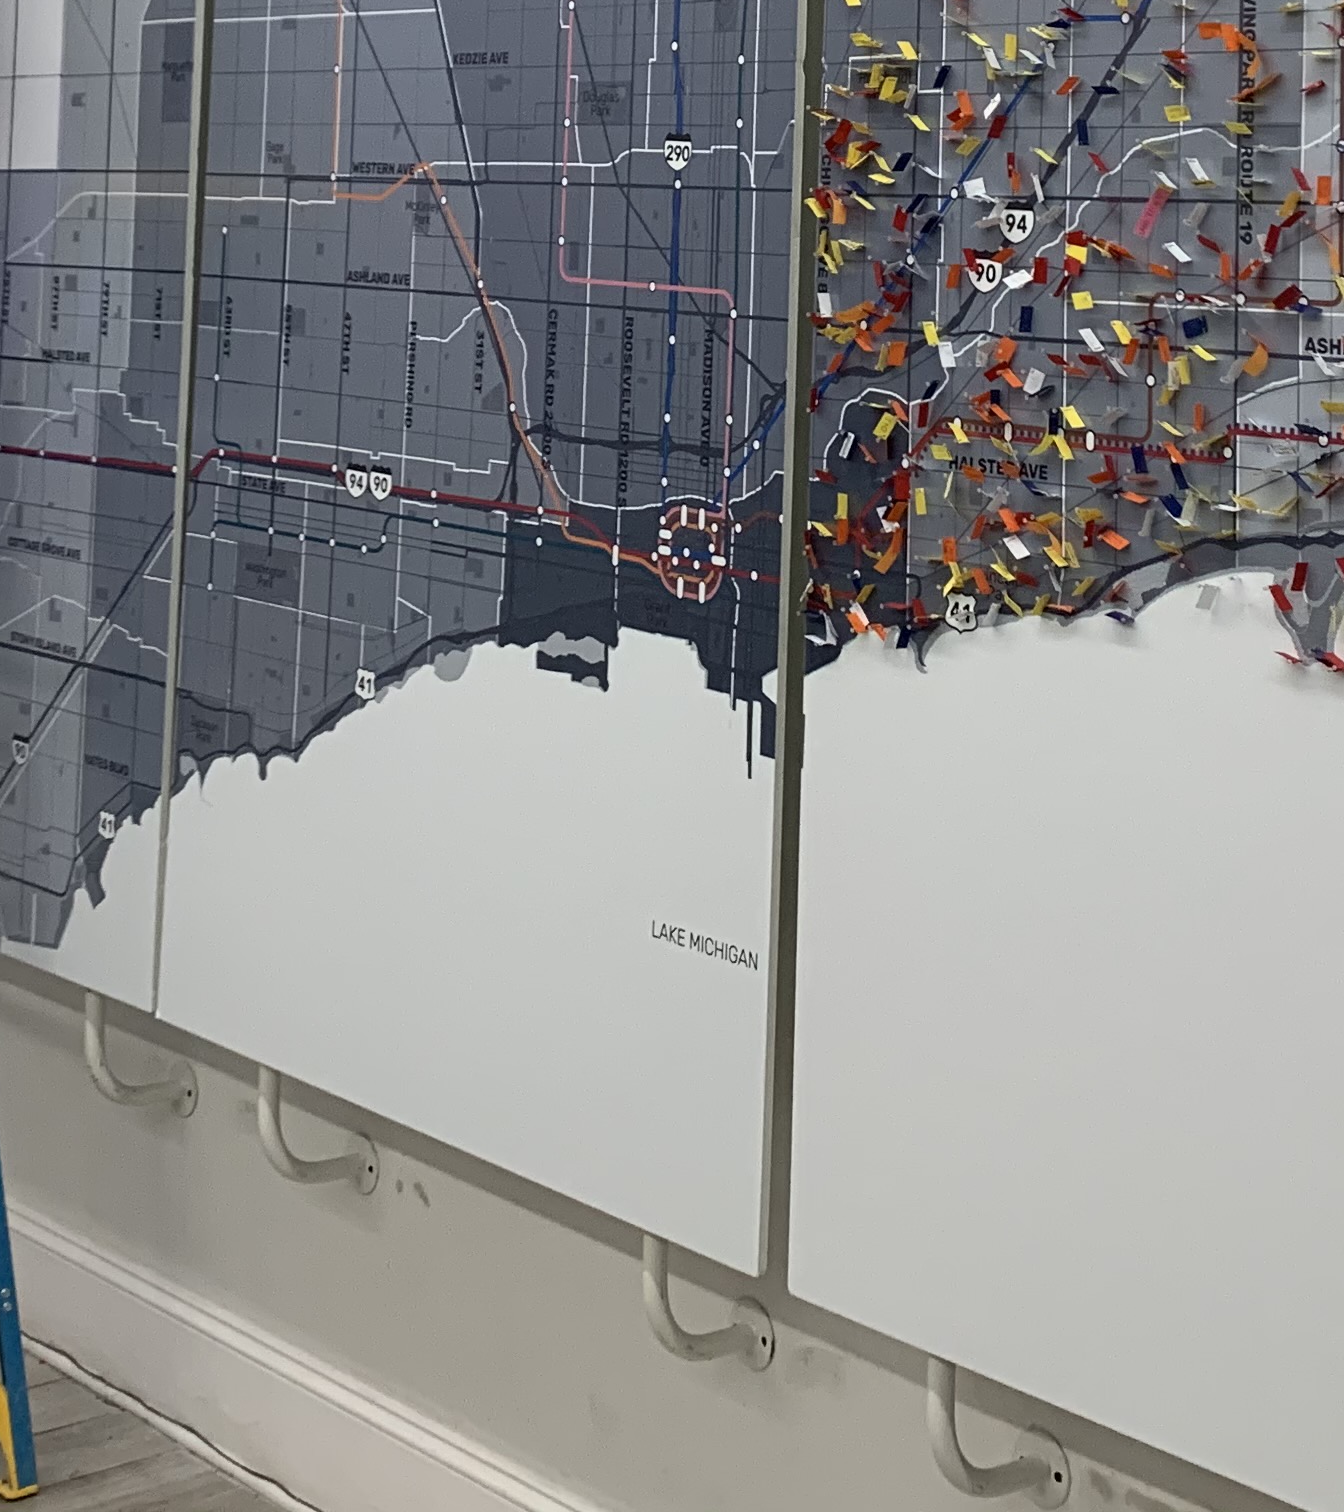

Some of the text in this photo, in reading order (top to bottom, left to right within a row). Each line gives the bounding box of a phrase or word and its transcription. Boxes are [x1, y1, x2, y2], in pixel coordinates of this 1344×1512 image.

[453, 51, 509, 66] KEDZIE AVE
[666, 144, 690, 163] 290
[353, 161, 416, 176] WESTERN AVE
[1239, 145, 1255, 215] ROUTE
[1005, 213, 1028, 234] 94
[1239, 220, 1253, 246] 19
[347, 269, 411, 286] ASHLAND AVE
[975, 263, 997, 284] 90
[544, 308, 559, 382] CERMAK
[619, 316, 635, 415] ROOSEVELT
[701, 329, 716, 411] MADISON
[543, 382, 555, 407] RD
[405, 405, 415, 429] RD
[618, 420, 631, 443] RD
[349, 473, 364, 491] 94
[616, 451, 630, 493] 1200
[1018, 464, 1049, 481] AVE
[373, 475, 388, 493] 90
[358, 675, 372, 694] 41
[651, 919, 759, 972] LAKE MICHIGAN
